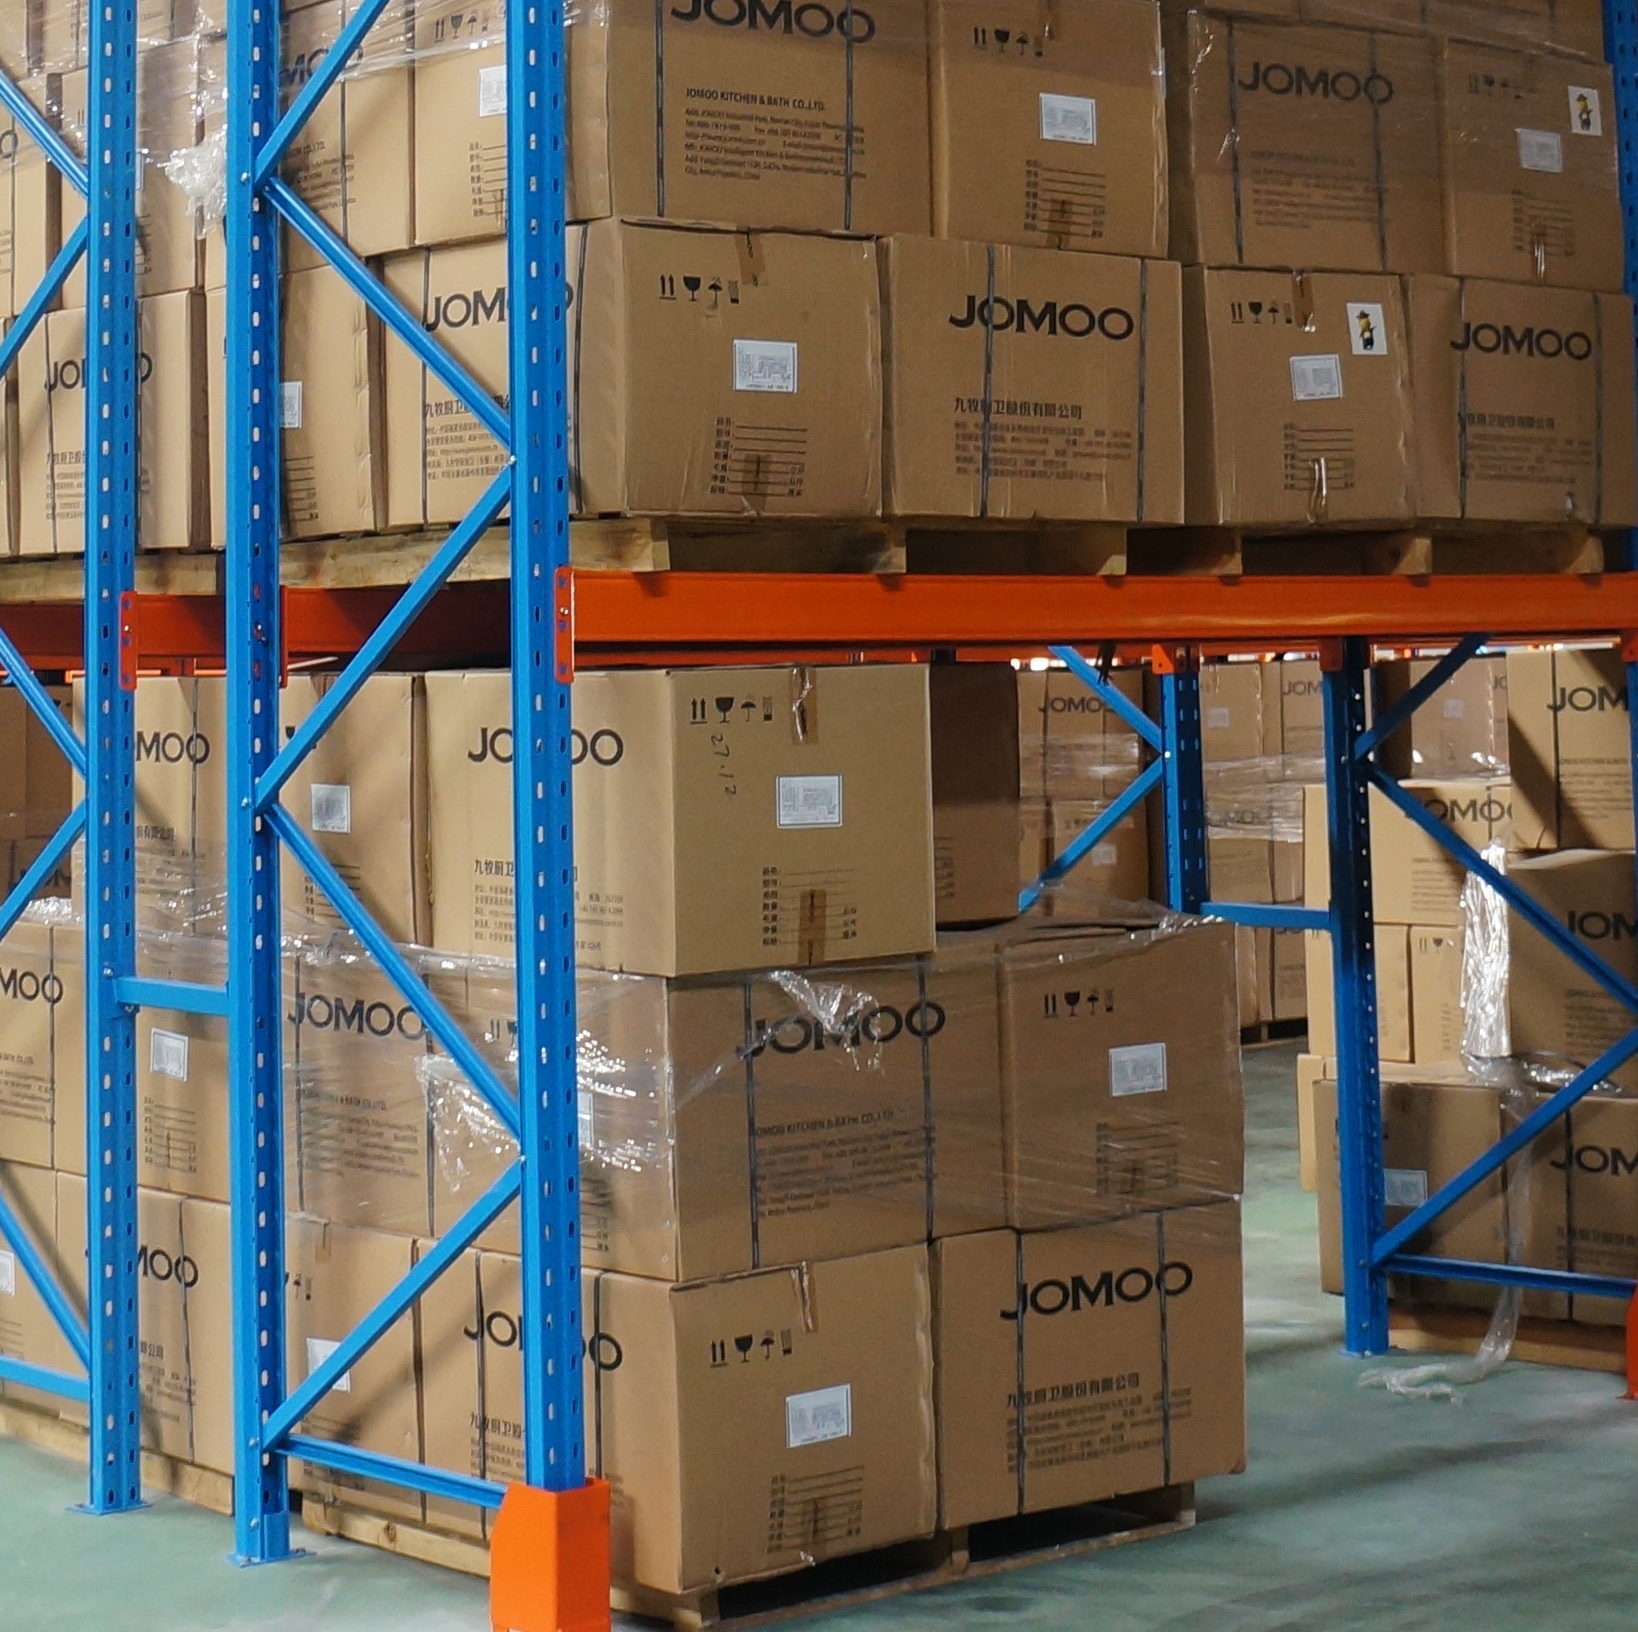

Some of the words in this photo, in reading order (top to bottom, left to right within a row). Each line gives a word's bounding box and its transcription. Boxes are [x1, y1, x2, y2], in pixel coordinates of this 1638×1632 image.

[686, 88, 718, 101] JOMOO
[720, 92, 757, 106] KITCHEN
[767, 95, 790, 109] BATH
[1237, 62, 1394, 105] JOMOO
[424, 285, 573, 331] JOMO
[949, 294, 1134, 340] JOMOO
[1450, 321, 1592, 360] JOMOO
[1281, 680, 1322, 696] JOM
[137, 731, 209, 765] MOO
[467, 727, 624, 767] JOOO
[999, 1260, 1193, 1321] JOMOO
